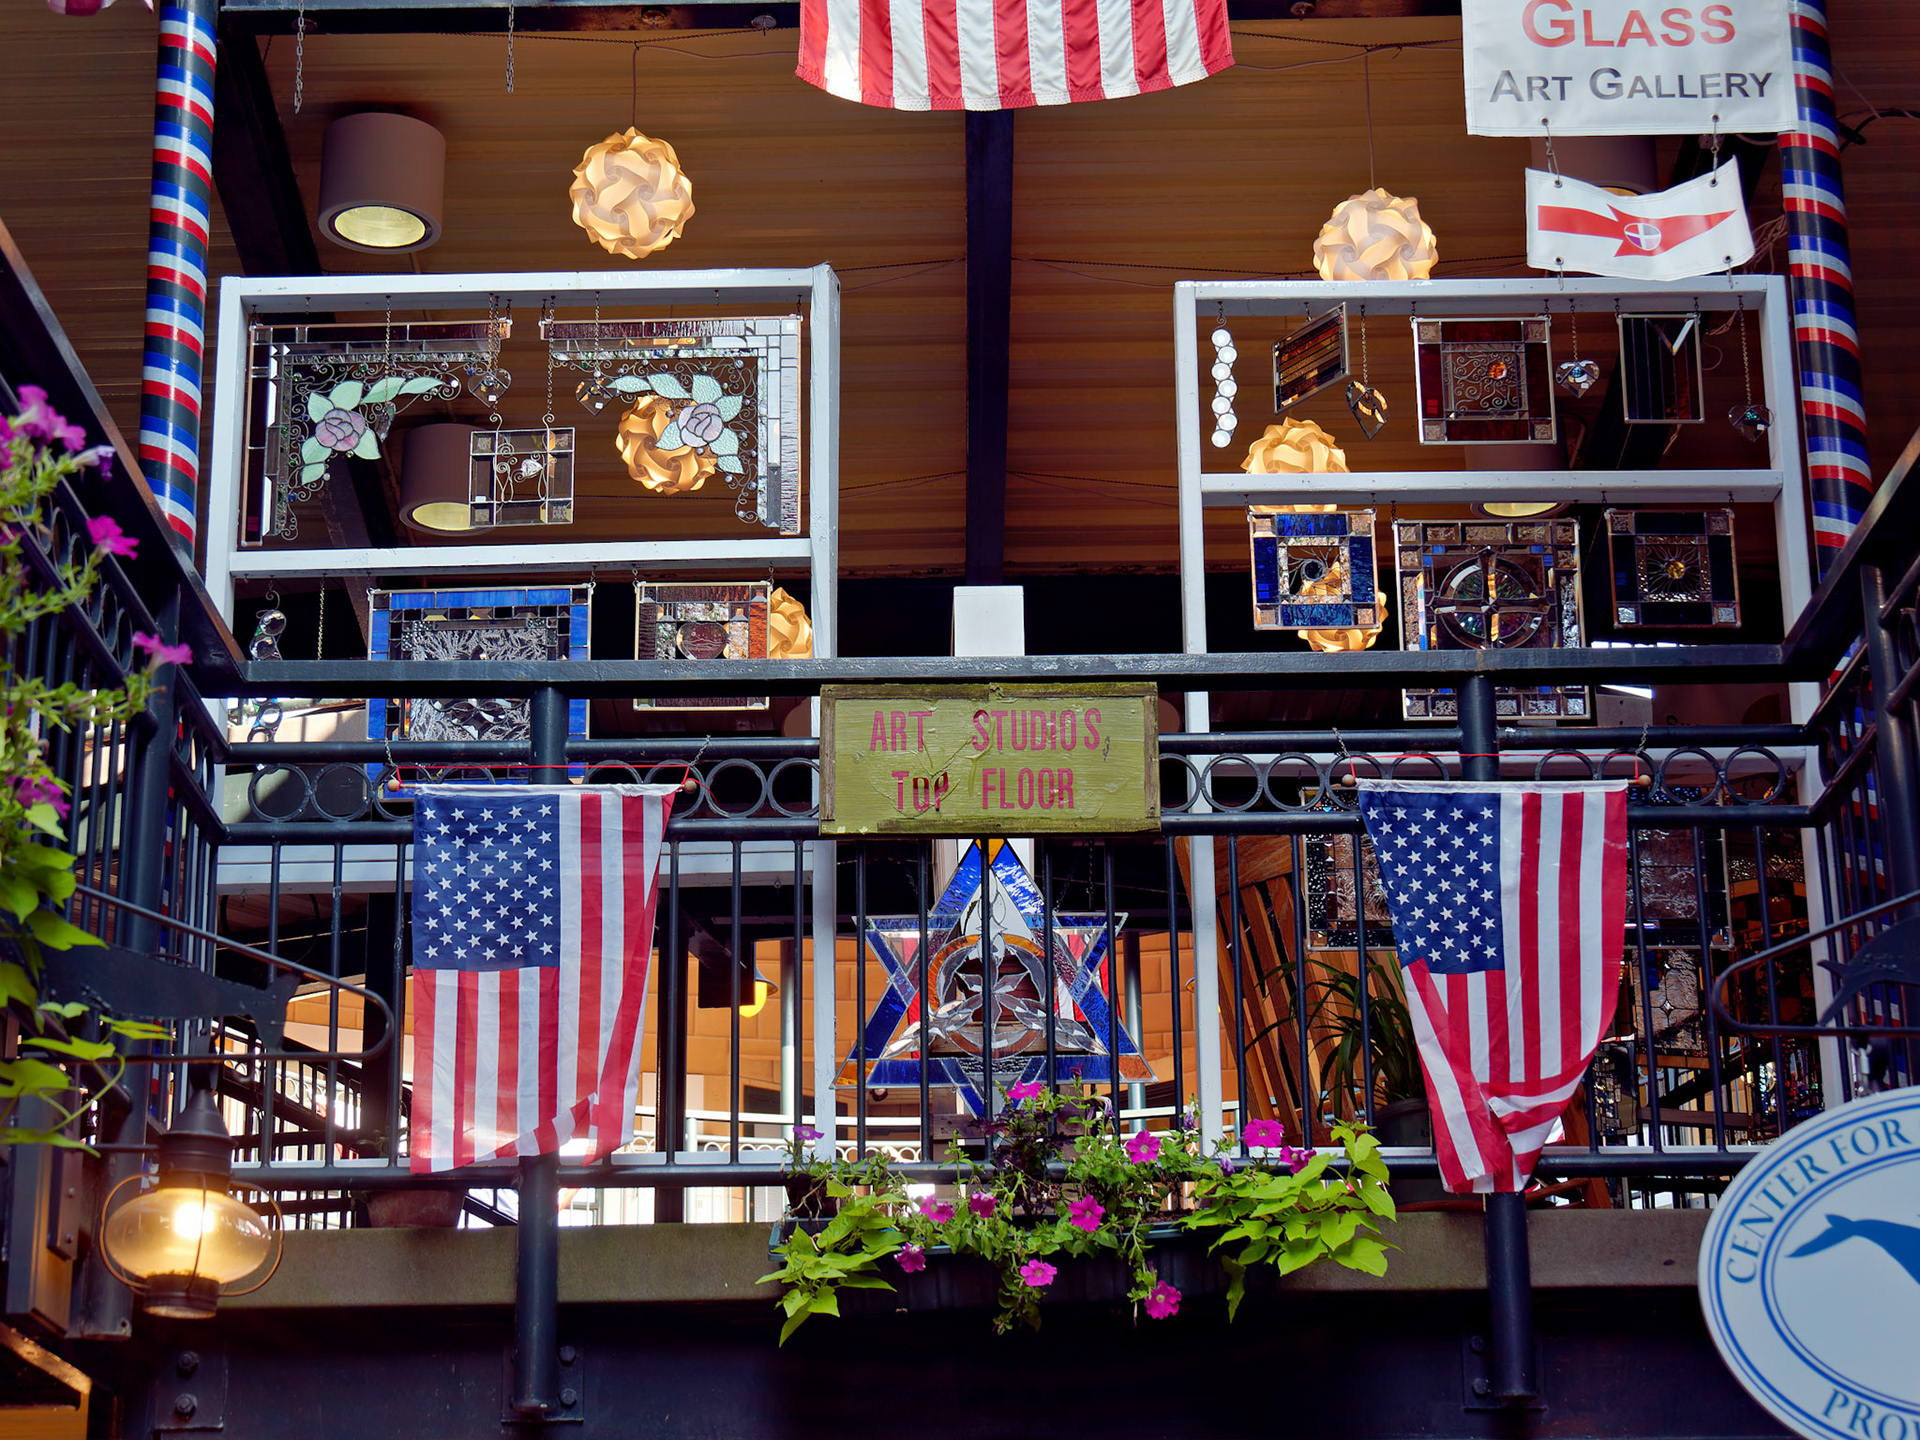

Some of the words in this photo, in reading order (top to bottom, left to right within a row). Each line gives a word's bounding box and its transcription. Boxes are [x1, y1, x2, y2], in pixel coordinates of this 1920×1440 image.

[1522, 0, 1736, 48] GLASS
[1489, 70, 1573, 102] ART
[1589, 67, 1773, 100] GALLERY
[870, 710, 932, 751] ART
[892, 771, 949, 812] TOP
[982, 768, 1075, 809] FLOOR
[1726, 1154, 1829, 1284] CENTER
[1829, 1119, 1912, 1166] FOR
[1823, 1388, 1920, 1440] PRO
